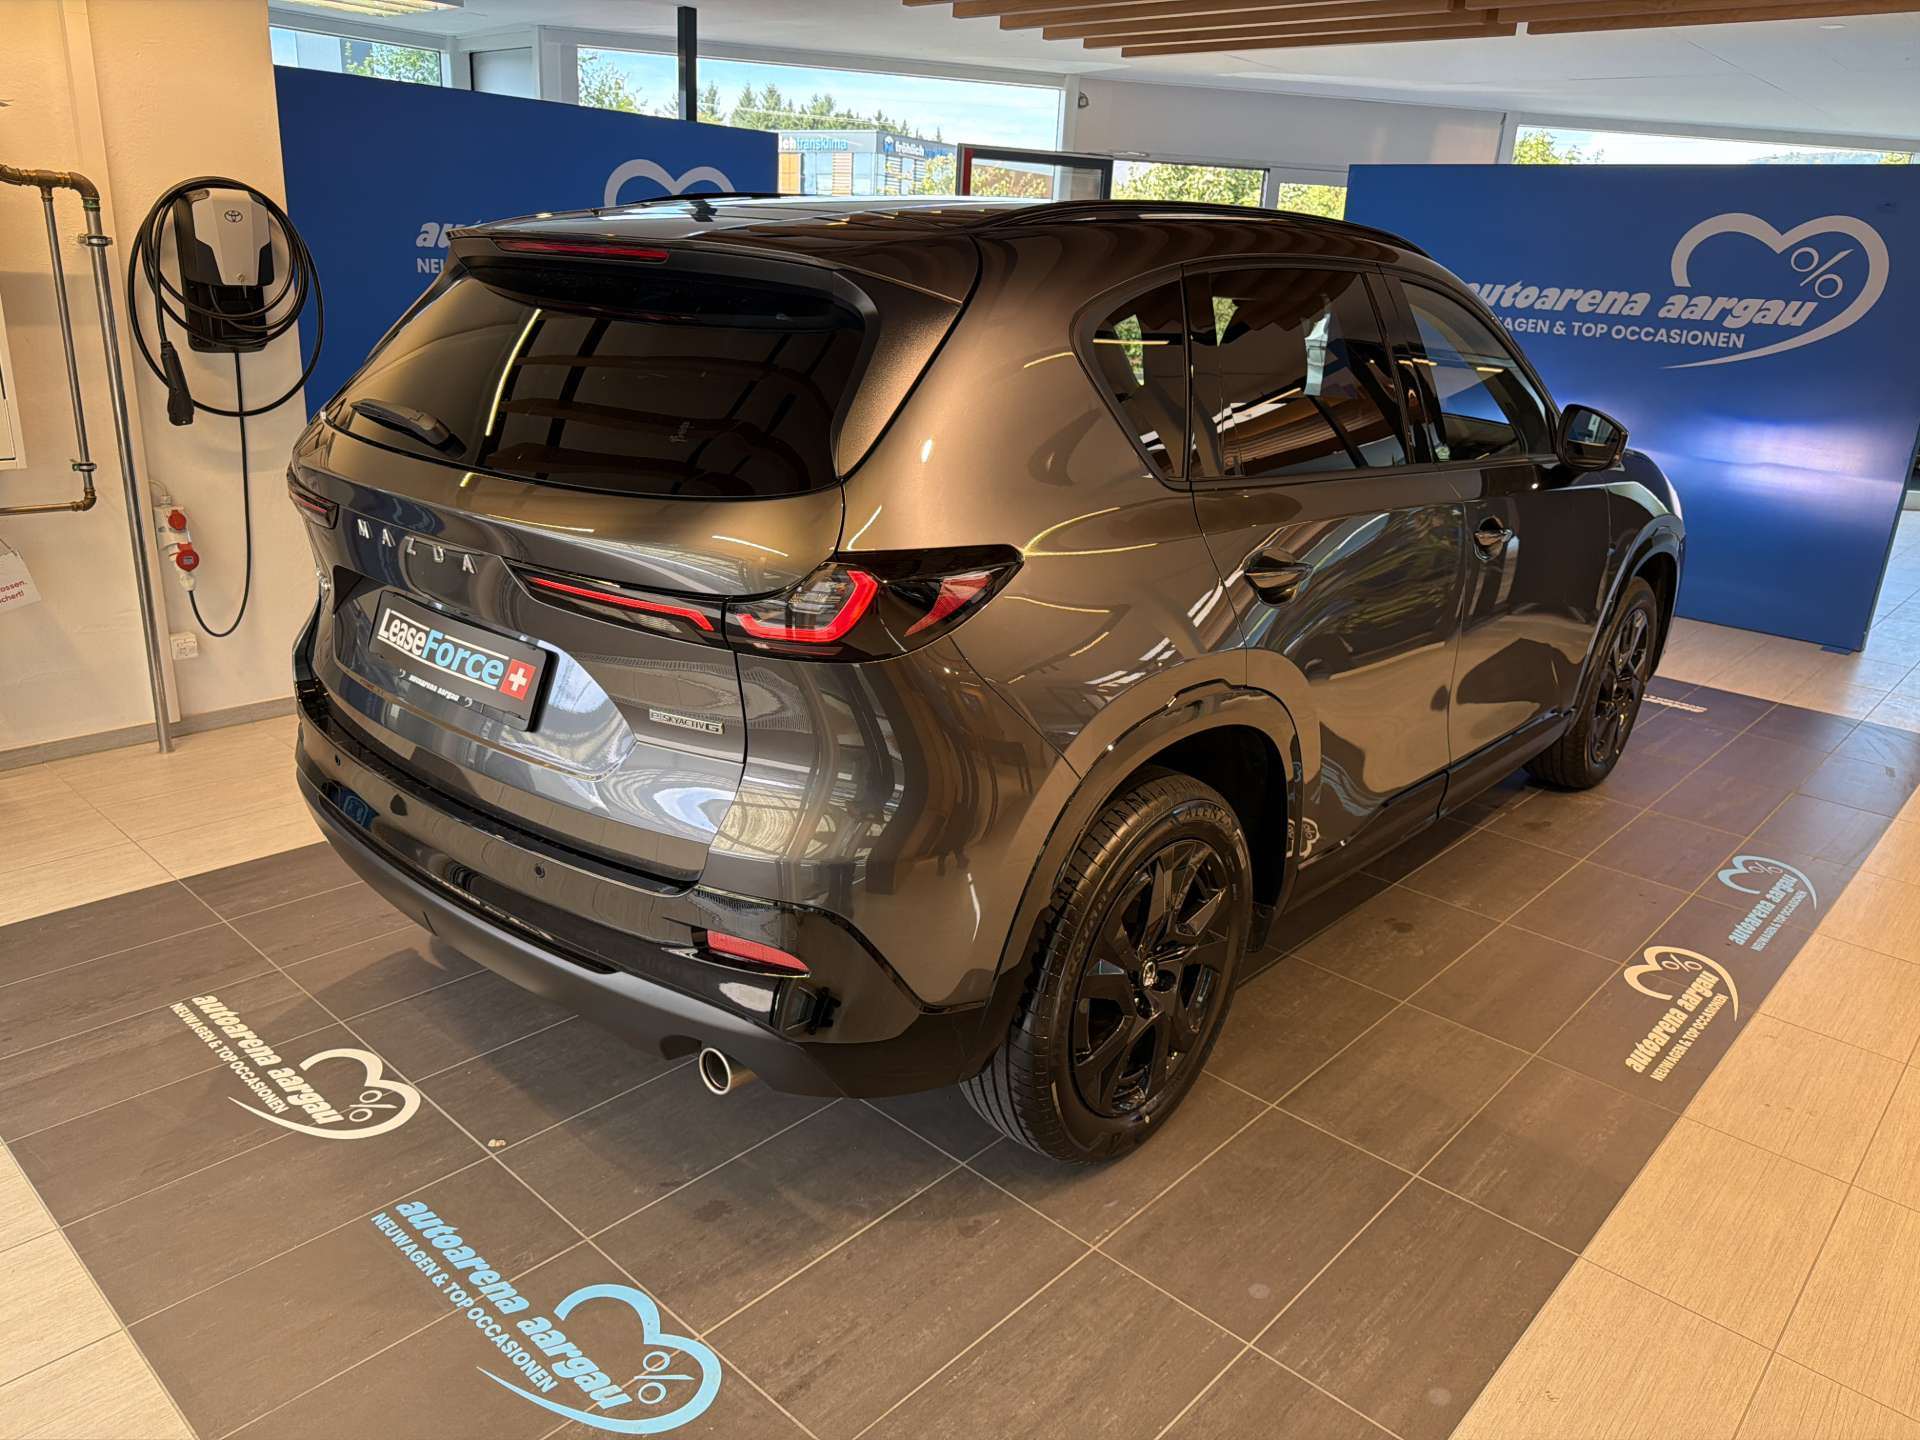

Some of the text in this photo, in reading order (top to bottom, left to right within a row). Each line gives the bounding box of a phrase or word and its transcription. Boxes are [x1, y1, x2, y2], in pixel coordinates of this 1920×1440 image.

[1499, 317, 1745, 349] AGEN & TOP OCCASIONEN
[1658, 294, 1818, 329] aargau
[0, 580, 28, 593] ossen.
[0, 589, 25, 604] chert!
[377, 608, 505, 686] LeaseForce
[1728, 873, 1798, 945] autoarena aargau
[169, 1002, 289, 1114] NEUWAGEN & TOP OCCASIONEN
[192, 995, 345, 1125] autoarena aargau
[1625, 970, 1720, 1073] autoarena aargau
[1649, 1043, 1688, 1082] NEUWAGEN
[1682, 1027, 1701, 1042] TOP
[1692, 993, 1729, 1030] OCCASIONEN
[371, 1212, 559, 1393] NEUWAGEN & TOP OCCASIONEN
[395, 1201, 633, 1410] autoarena aargau
